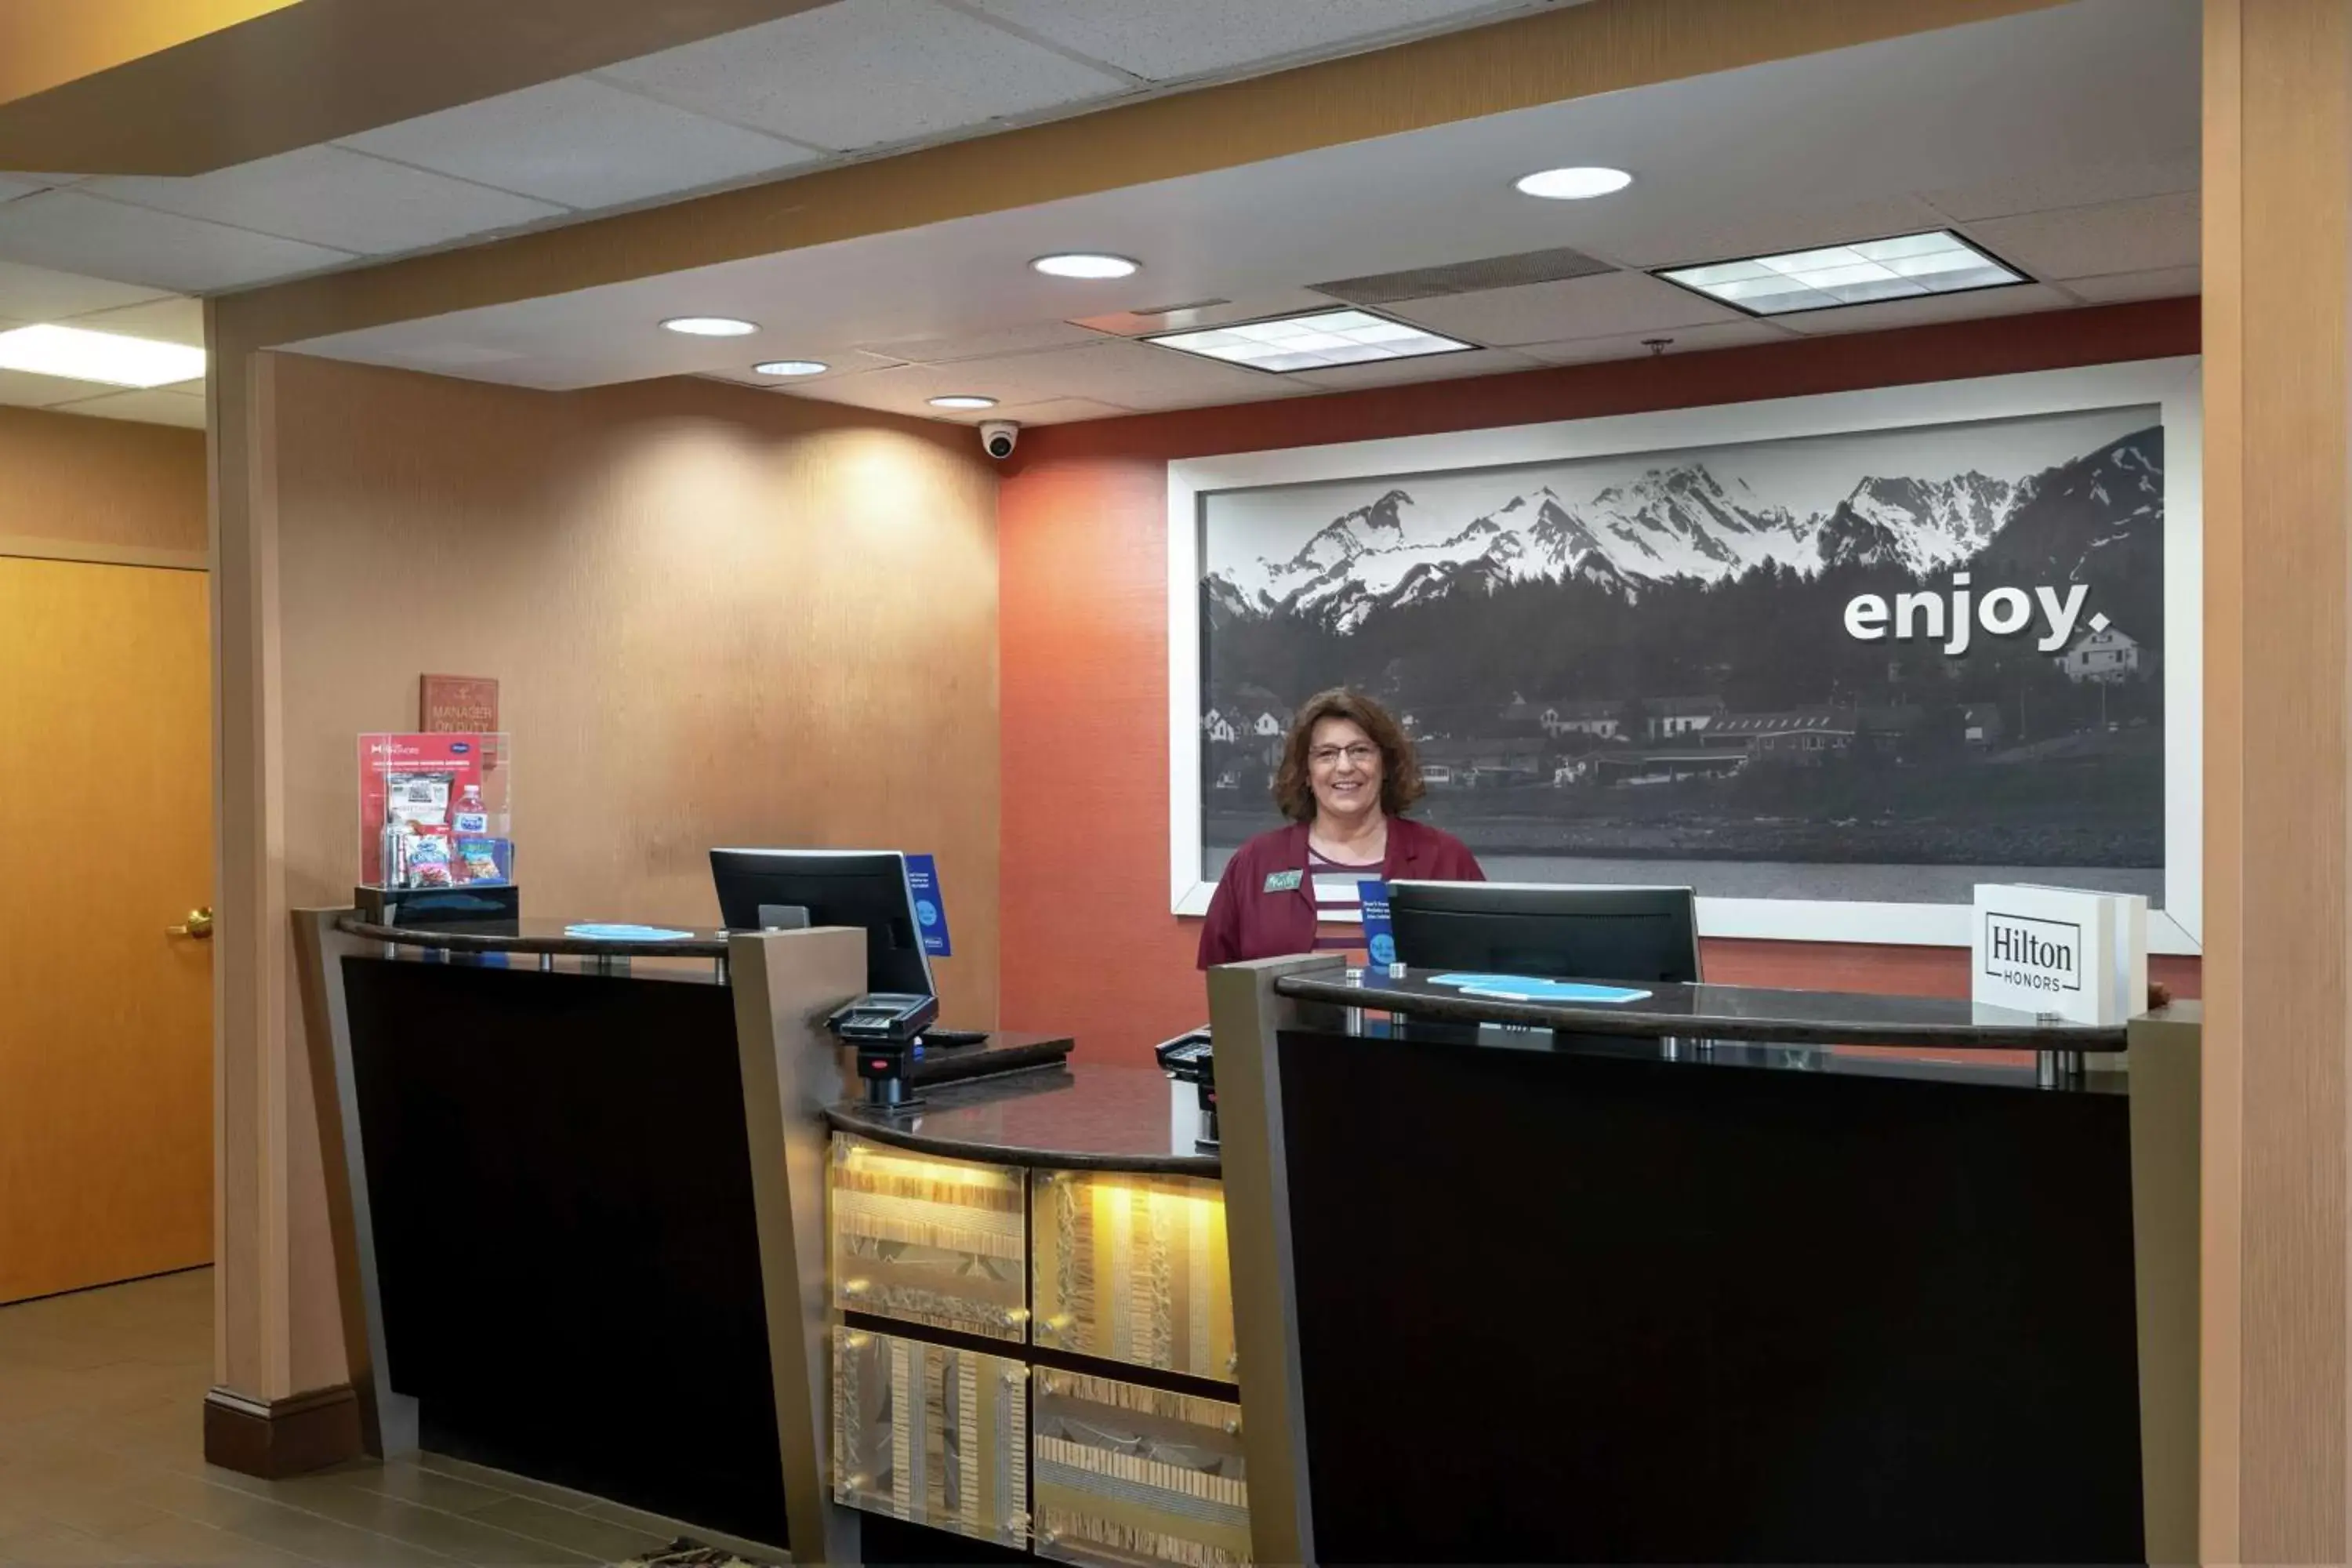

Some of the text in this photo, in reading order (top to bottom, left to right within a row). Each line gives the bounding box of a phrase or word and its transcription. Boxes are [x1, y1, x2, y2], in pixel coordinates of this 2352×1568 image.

[1844, 572, 2111, 655] enjoy.
[432, 706, 492, 720] MANAGER
[1993, 925, 2072, 971] Hilton
[2004, 970, 2060, 992] HONORS
